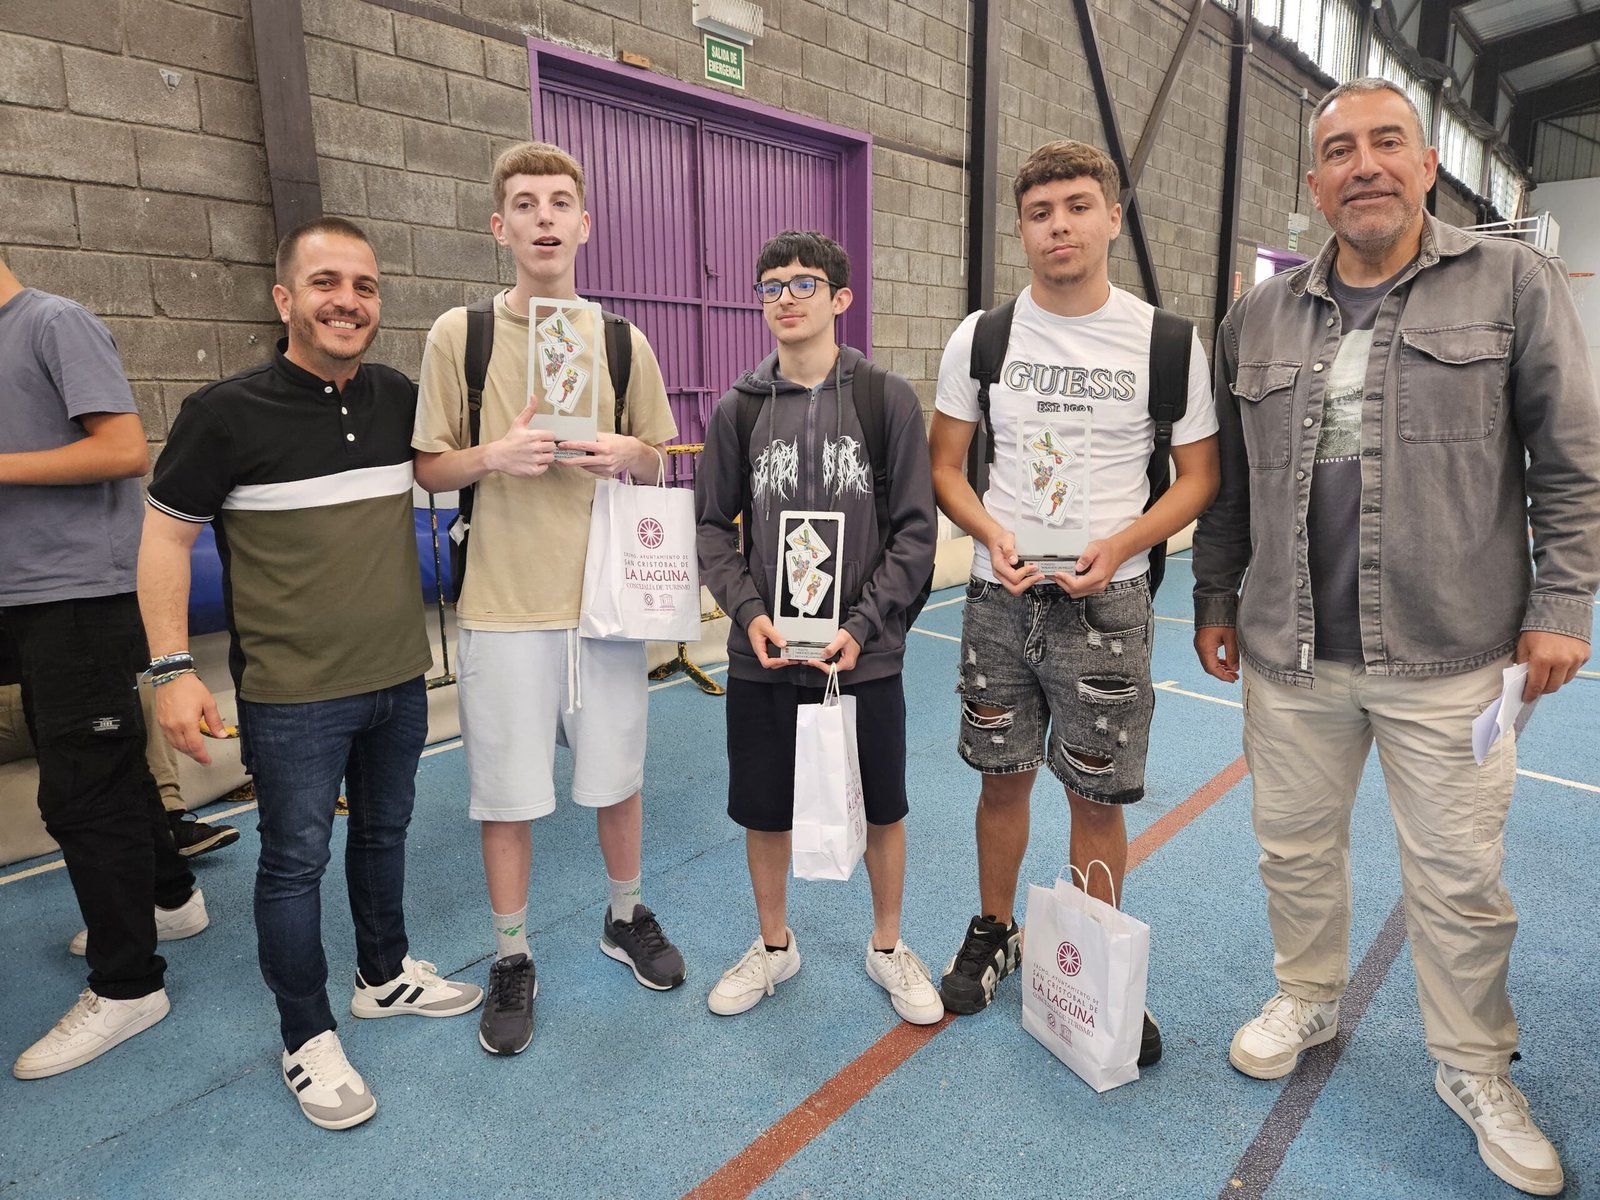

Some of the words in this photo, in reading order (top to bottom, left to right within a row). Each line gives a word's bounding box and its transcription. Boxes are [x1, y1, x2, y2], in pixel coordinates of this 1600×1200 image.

[711, 45, 730, 62] SALIDA
[730, 51, 738, 65] DE
[708, 59, 741, 81] EMERGENCIA
[1004, 360, 1136, 402] GUESS
[624, 559, 635, 567] SAN
[625, 567, 638, 580] LA
[640, 569, 690, 582] LAGUNA
[1032, 969, 1045, 981] SAN
[1089, 1003, 1098, 1014] DE
[1051, 975, 1091, 1001] AYUNTAMIENTO
[1032, 977, 1045, 996] LA
[1047, 988, 1095, 1029] LAGUNA
